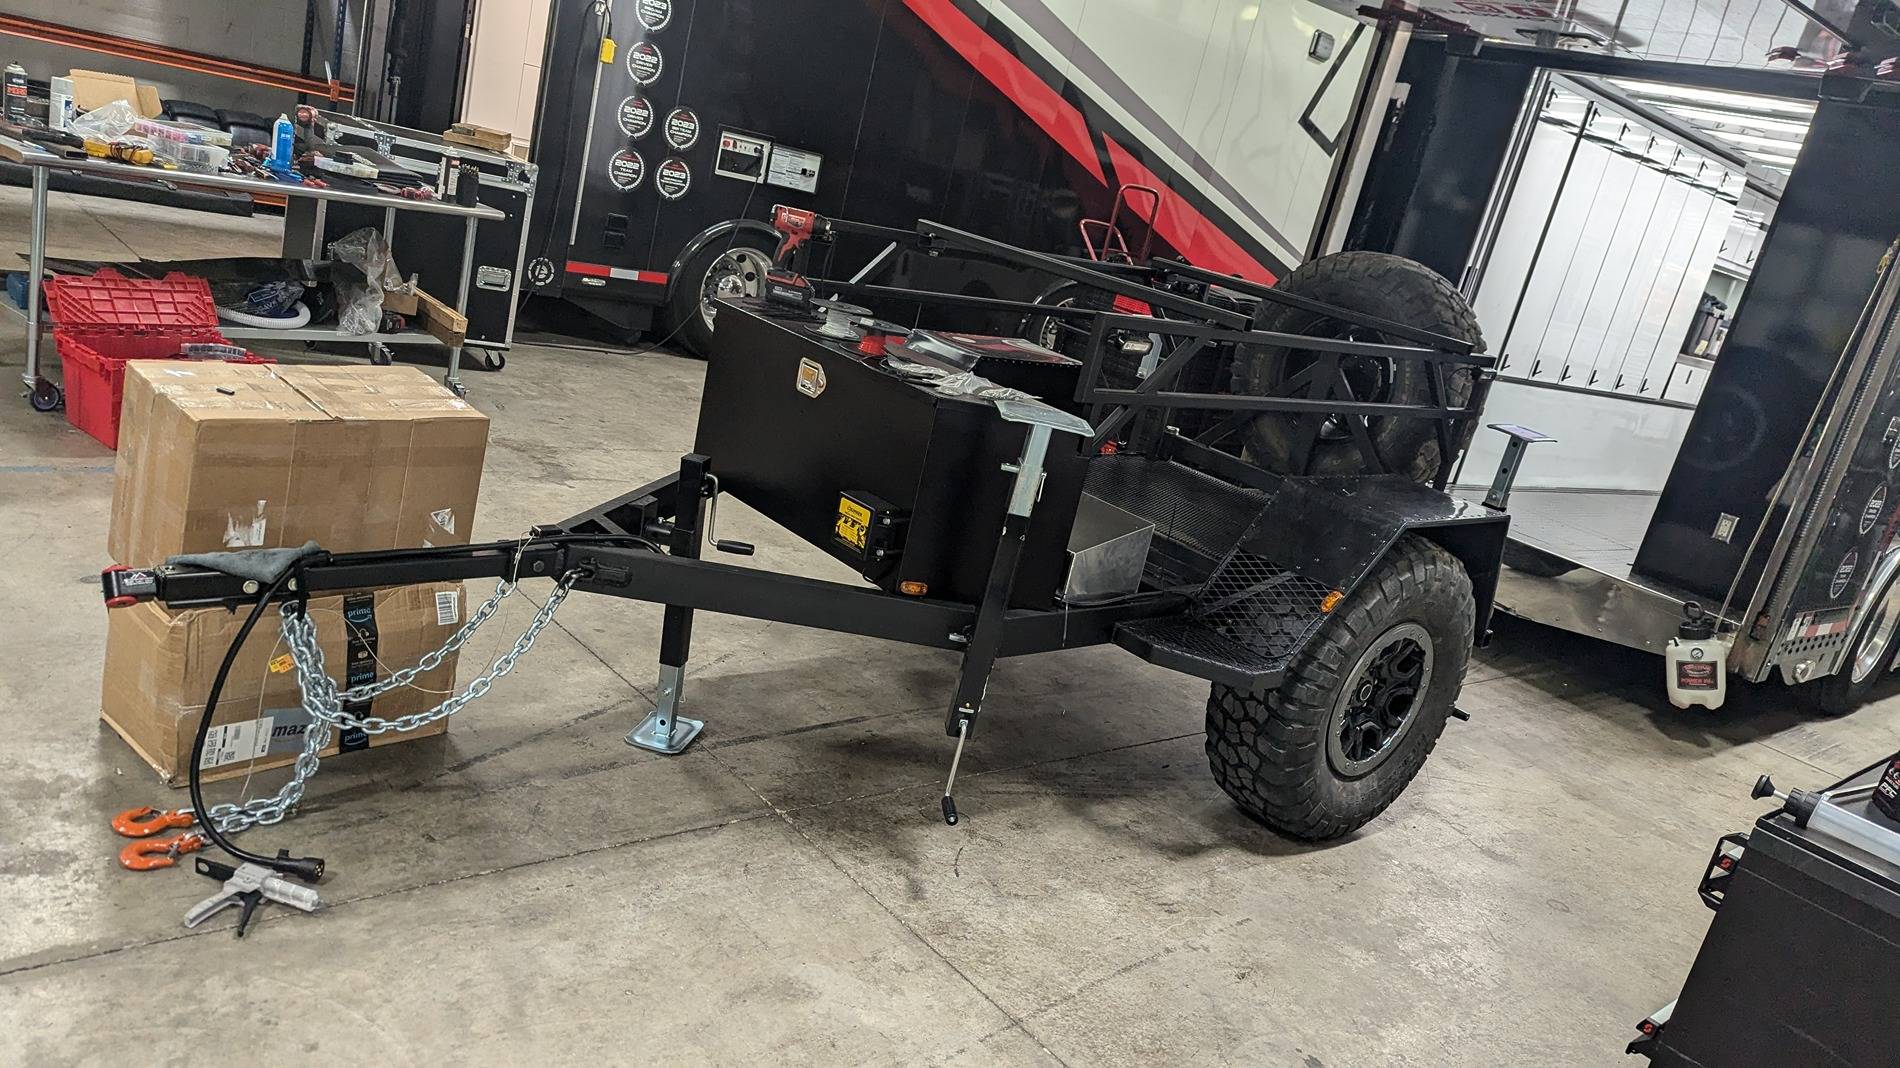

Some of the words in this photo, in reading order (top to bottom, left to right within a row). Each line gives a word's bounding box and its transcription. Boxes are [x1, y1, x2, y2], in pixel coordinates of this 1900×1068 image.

[640, 9, 665, 19] CHAMPION
[632, 52, 659, 64] 2022
[631, 64, 656, 73] CHAMPION
[636, 60, 653, 68] DRIVER
[623, 106, 649, 117] 2022
[622, 117, 647, 126] CHAMPION
[669, 130, 693, 138] CHAMPION
[614, 159, 640, 170] 2022
[613, 170, 638, 179] CHAMPION
[662, 169, 686, 179] 2023
[347, 607, 372, 618] prime
[350, 671, 375, 684] prime
